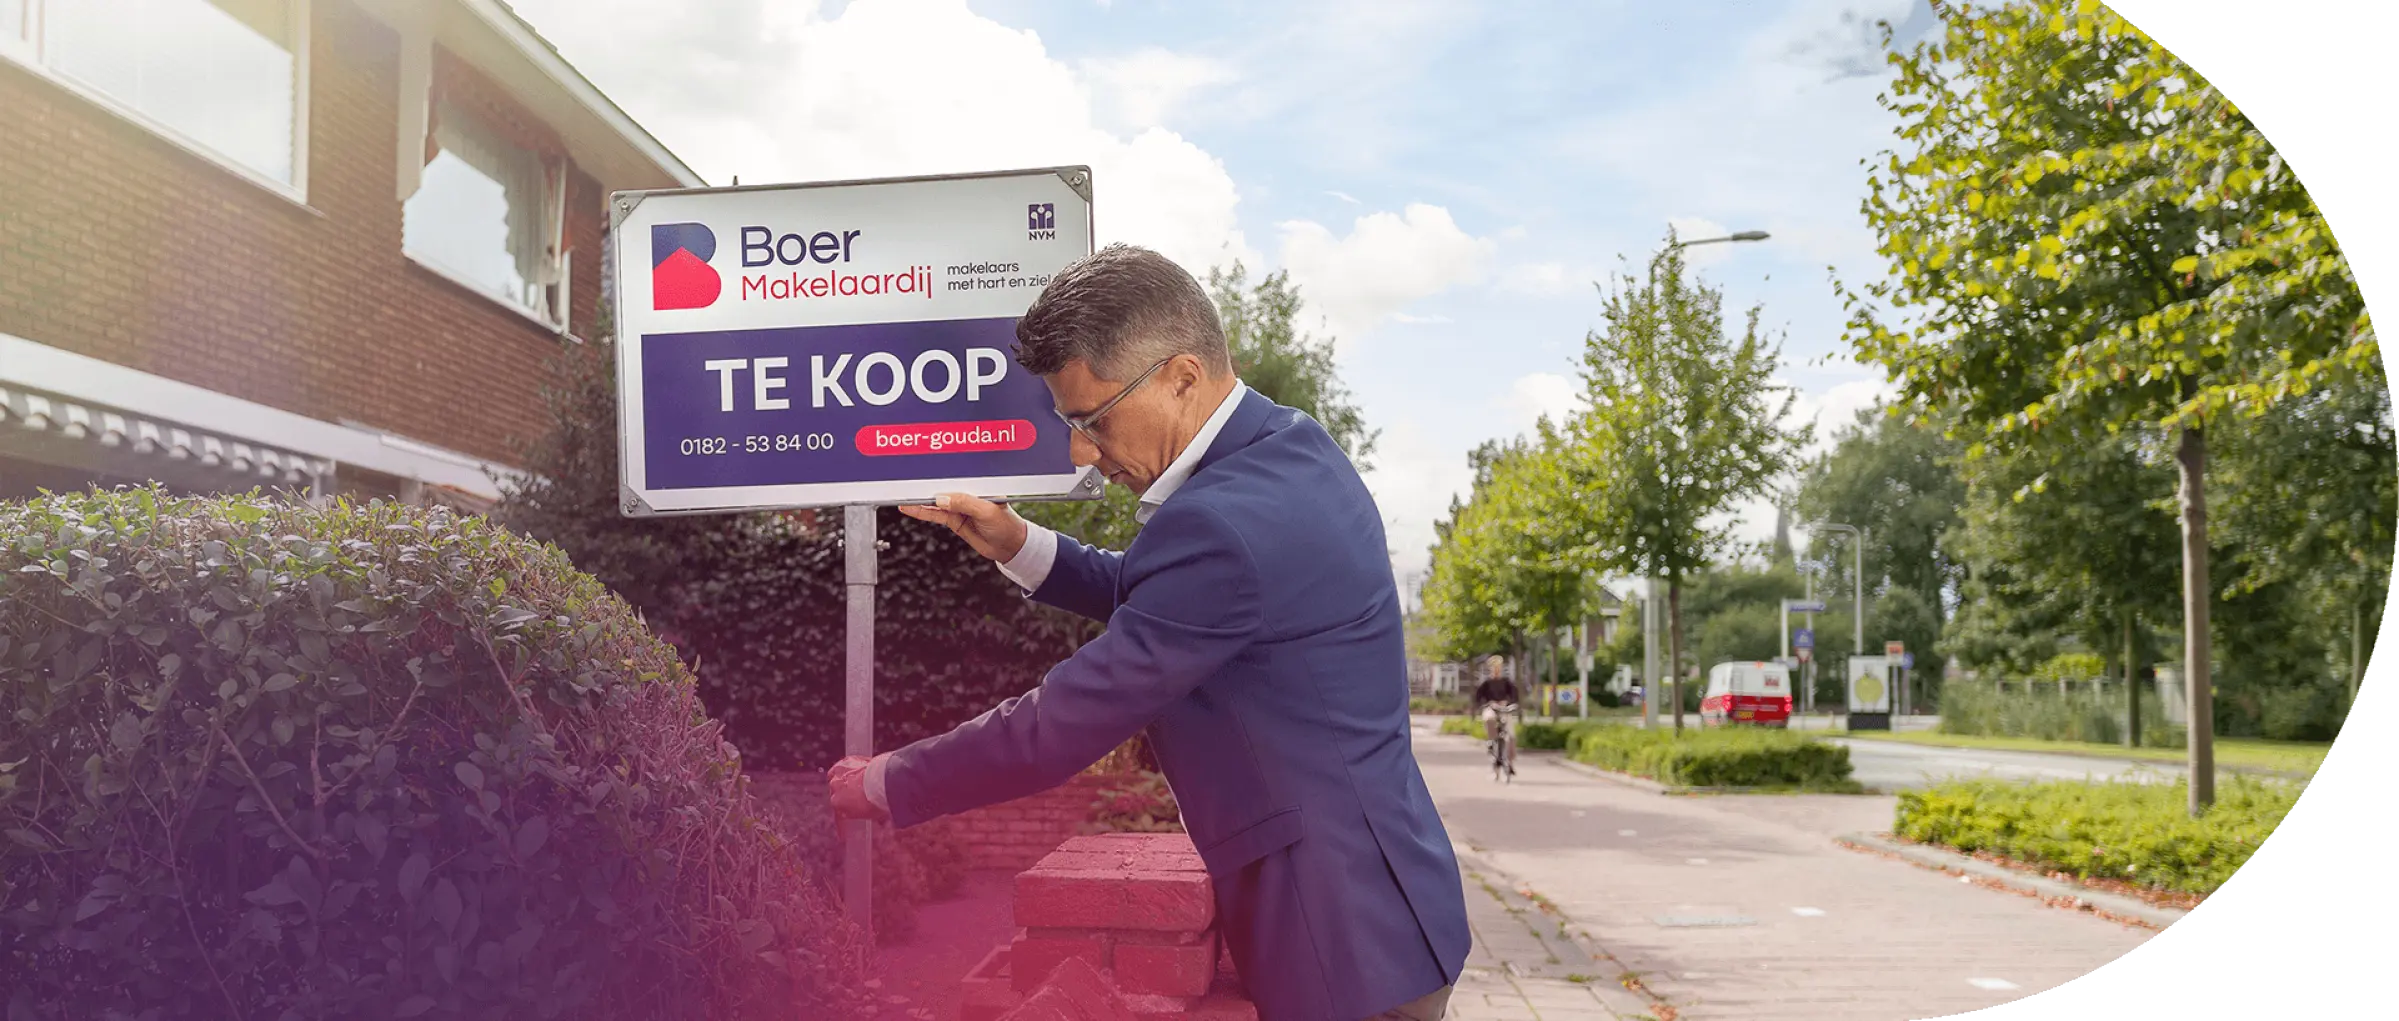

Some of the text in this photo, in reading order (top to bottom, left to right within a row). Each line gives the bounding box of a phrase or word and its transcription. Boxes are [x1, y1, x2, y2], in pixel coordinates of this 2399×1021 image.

[740, 225, 861, 268] Boer
[1028, 230, 1056, 241] NVM
[947, 261, 1020, 276] makelaars
[742, 265, 932, 301] Makelaardij
[947, 273, 1052, 291] met hart en ziel
[705, 347, 1008, 412] TE KOOP
[680, 437, 727, 456] 0182
[745, 435, 770, 453] 53
[775, 434, 802, 452] 84
[806, 433, 834, 450] 00
[875, 424, 1016, 450] boer-gouda.nl
